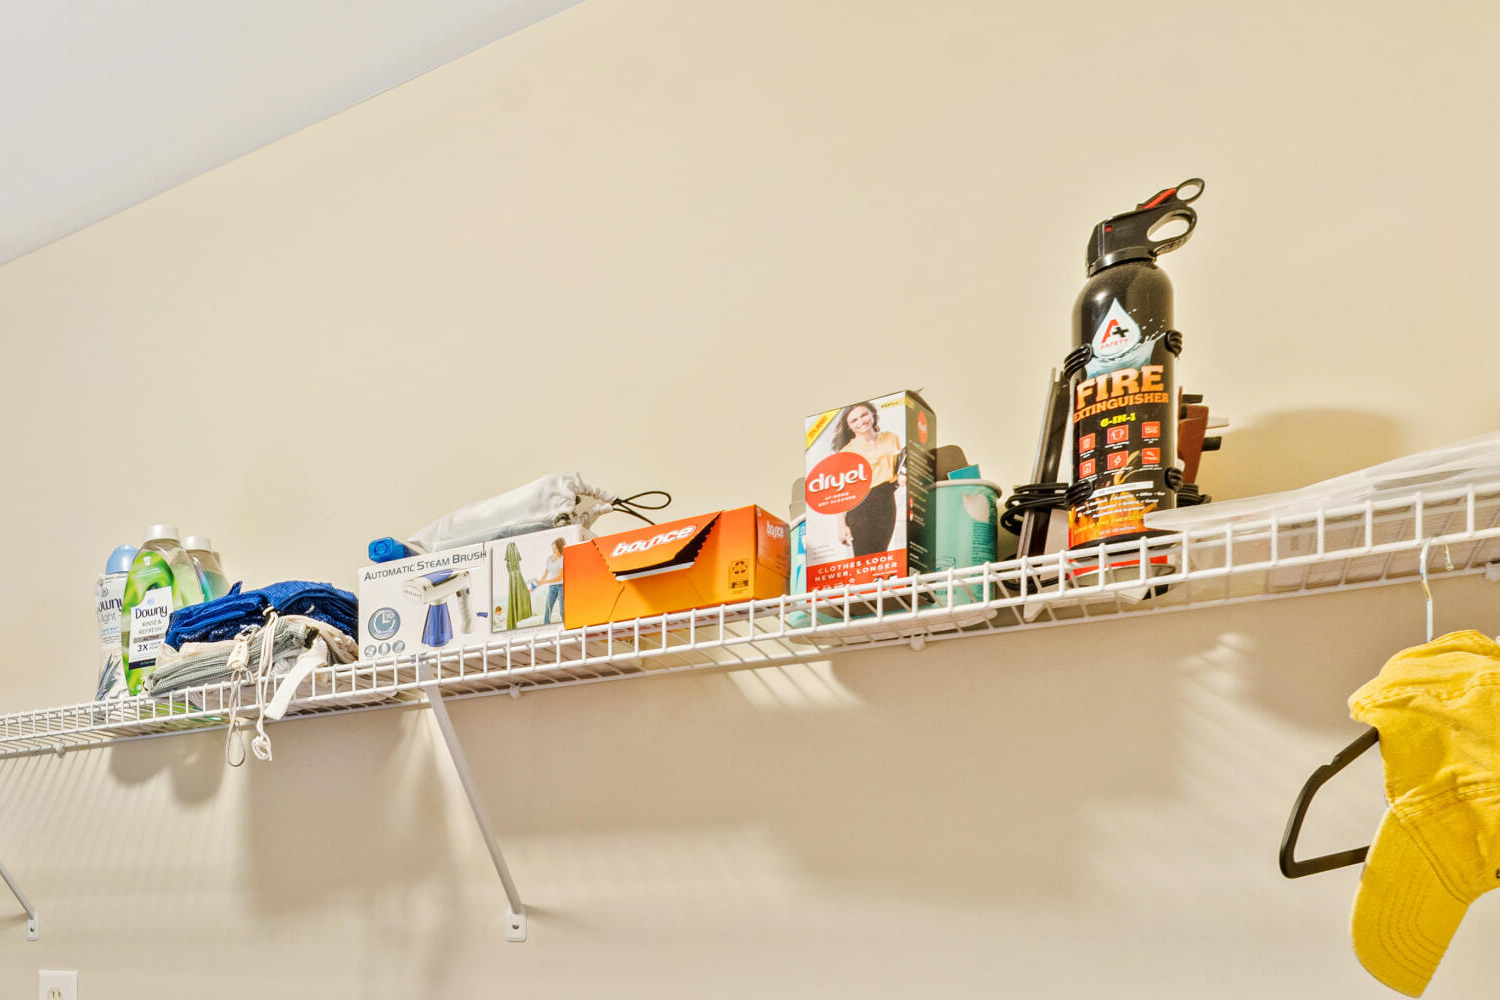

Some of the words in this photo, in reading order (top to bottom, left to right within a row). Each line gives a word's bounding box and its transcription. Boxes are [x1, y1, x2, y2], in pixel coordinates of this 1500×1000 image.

[1076, 365, 1164, 410] FIRE
[1073, 392, 1169, 424] EXTINGUISHER
[1100, 412, 1136, 427] 6-IN-1
[808, 463, 868, 493] dryel
[611, 525, 697, 557] bounce
[364, 564, 416, 581] AUTOMATIC
[417, 556, 450, 571] STEAM
[452, 550, 487, 564] BRUSH
[818, 561, 861, 574] CLOTHES
[866, 555, 894, 565] LOOK
[856, 562, 898, 574] LONGER
[99, 598, 123, 612] owny
[135, 605, 168, 619] Downy
